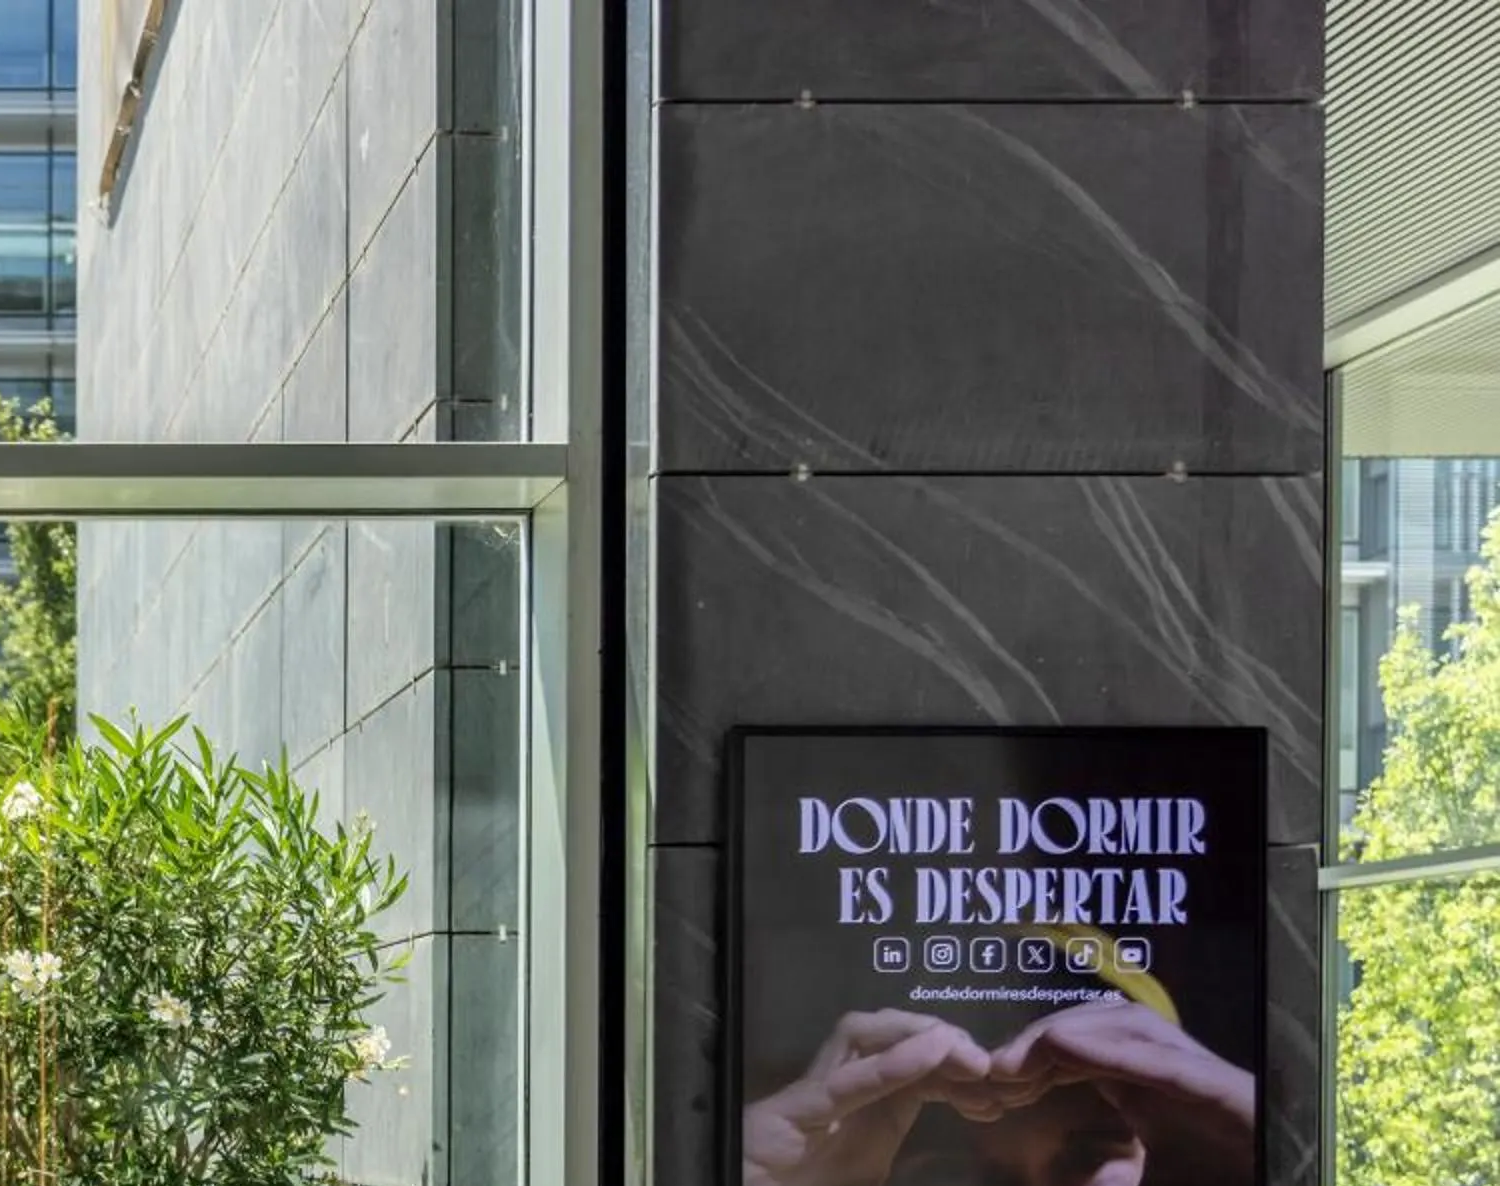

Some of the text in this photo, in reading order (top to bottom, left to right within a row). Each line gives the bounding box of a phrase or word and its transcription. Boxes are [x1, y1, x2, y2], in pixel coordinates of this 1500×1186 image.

[799, 797, 1206, 854] DONDE DORMIR
[838, 867, 1188, 924] ES DESPERTAR
[910, 984, 1121, 1004] dondedormiresdespertar.es
